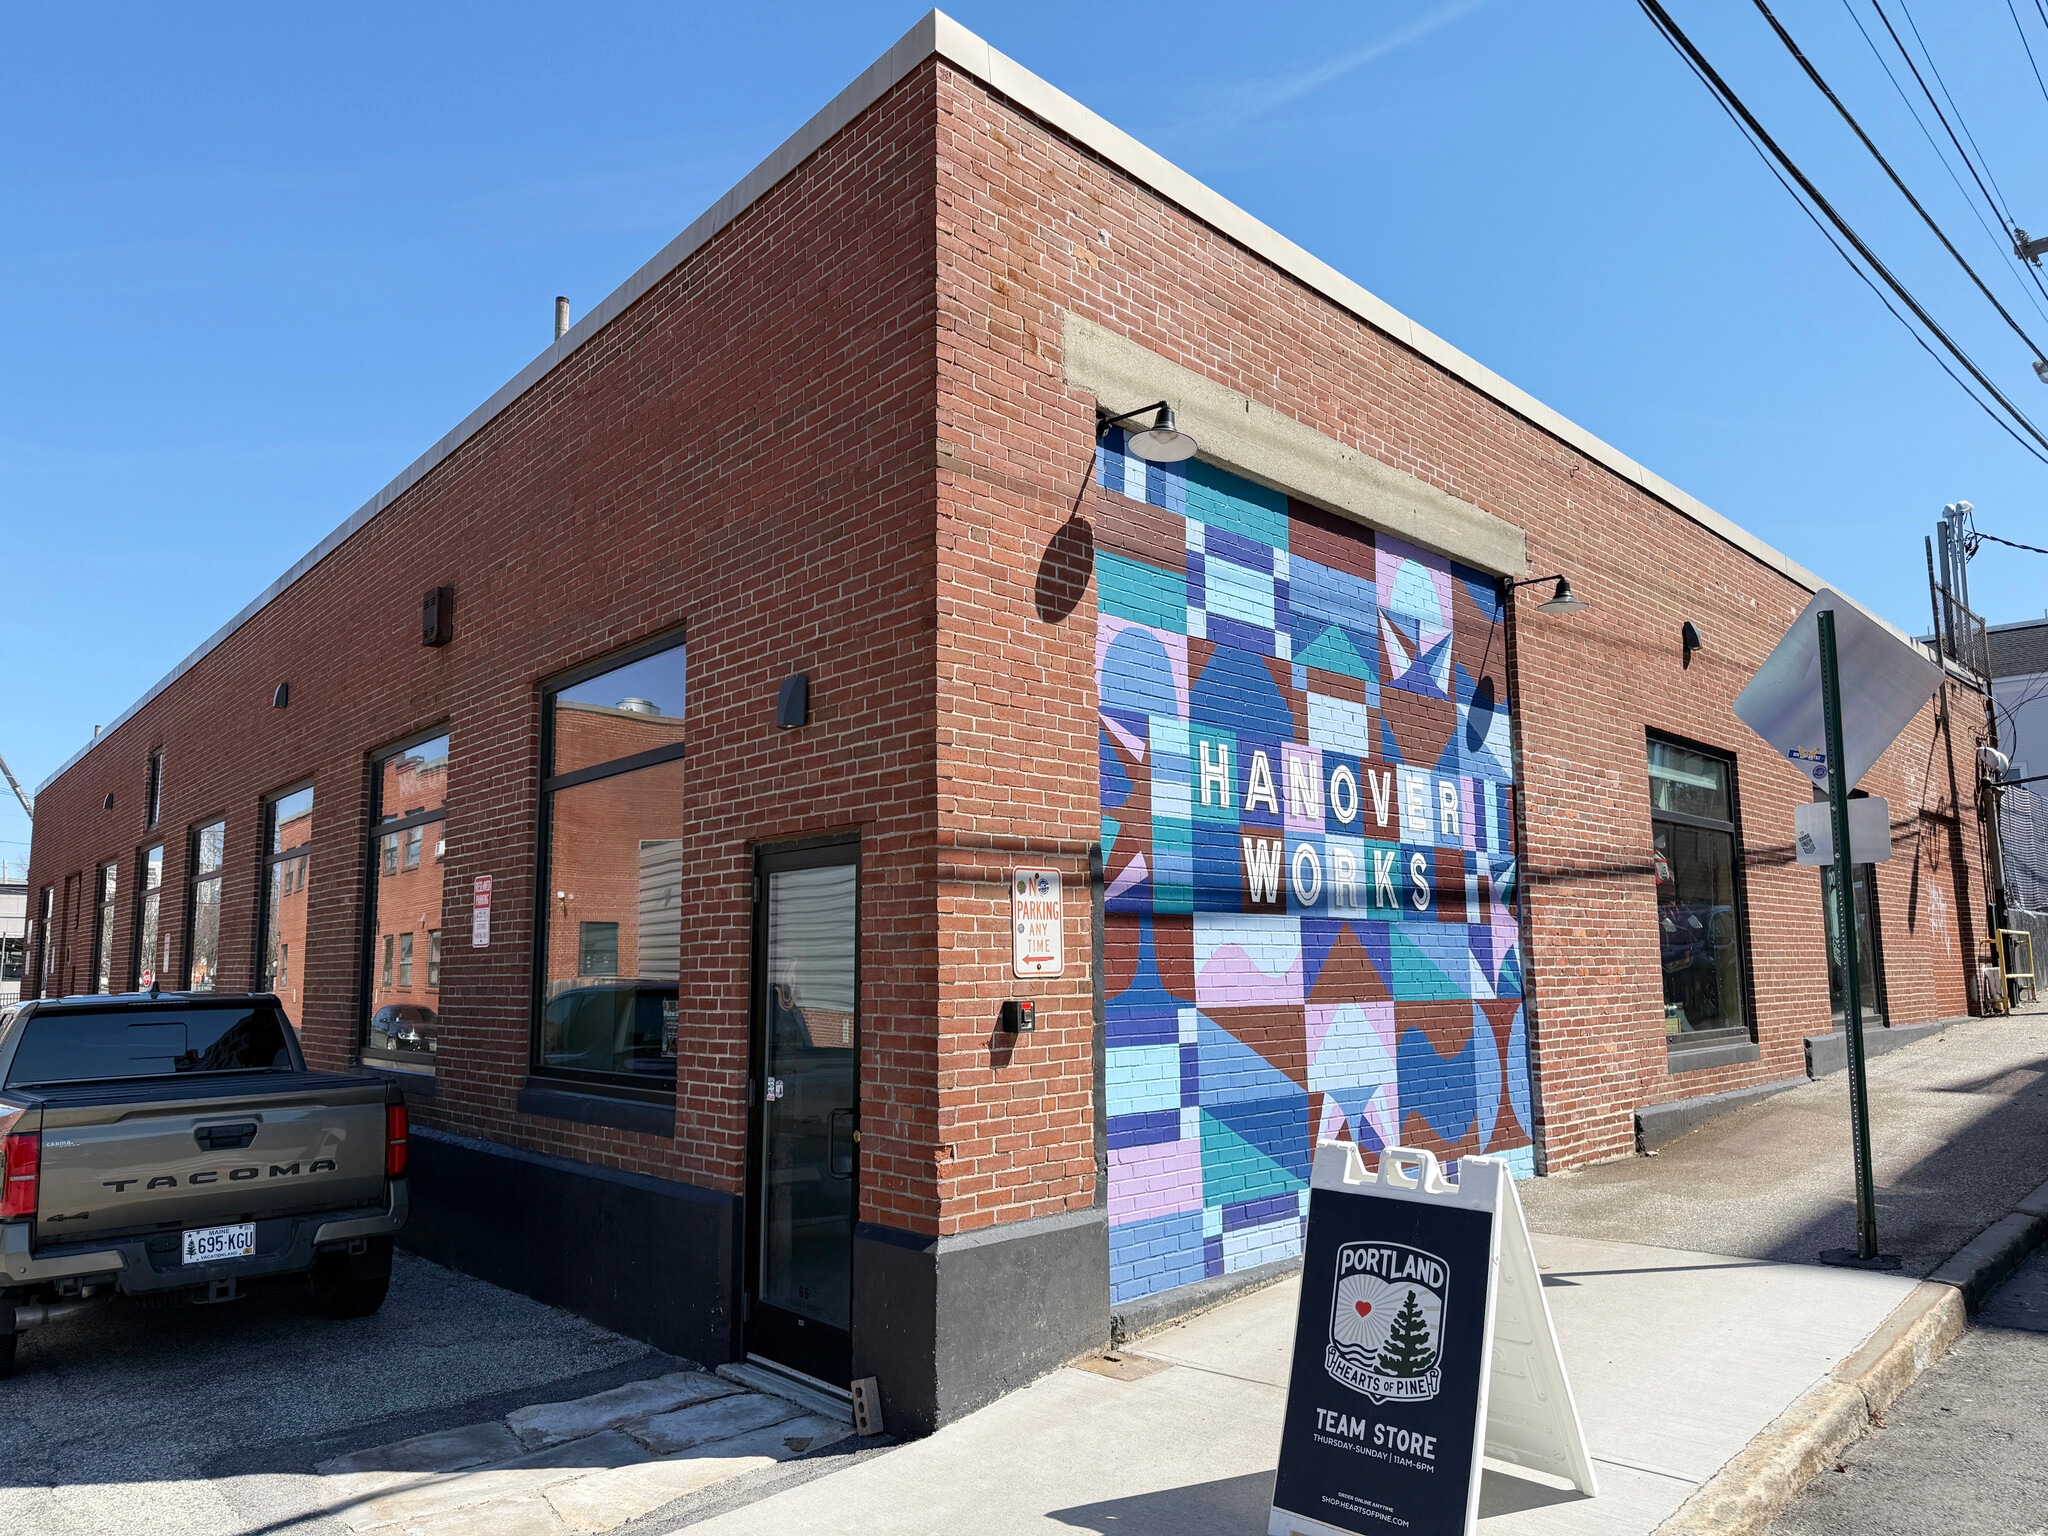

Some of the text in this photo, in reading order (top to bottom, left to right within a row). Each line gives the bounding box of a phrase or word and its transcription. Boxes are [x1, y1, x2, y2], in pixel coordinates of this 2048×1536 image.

[1199, 740, 1460, 836] HANOVER
[1242, 837, 1431, 911] WORKS
[1017, 900, 1059, 920] PARKING
[1027, 939, 1050, 952] TIME
[1029, 923, 1048, 936] ANY
[102, 1158, 337, 1193] TACOMA
[208, 1228, 230, 1236] MAINE
[201, 1250, 238, 1260] VACATIONLAND
[1341, 1248, 1444, 1288] PORTLAND
[798, 1286, 809, 1300] 65
[1335, 1363, 1427, 1395] HEARTS OF PINE
[1316, 1407, 1437, 1460] TEAM STORE
[1313, 1433, 1388, 1460] THURSDAY-SUNDAY
[1394, 1455, 1434, 1473] 11AM-6PM
[1321, 1495, 1410, 1528] SHOP.HEARTSOFPINE.COM
[1338, 1491, 1394, 1513] ORDER ONLINE ANYTIME
